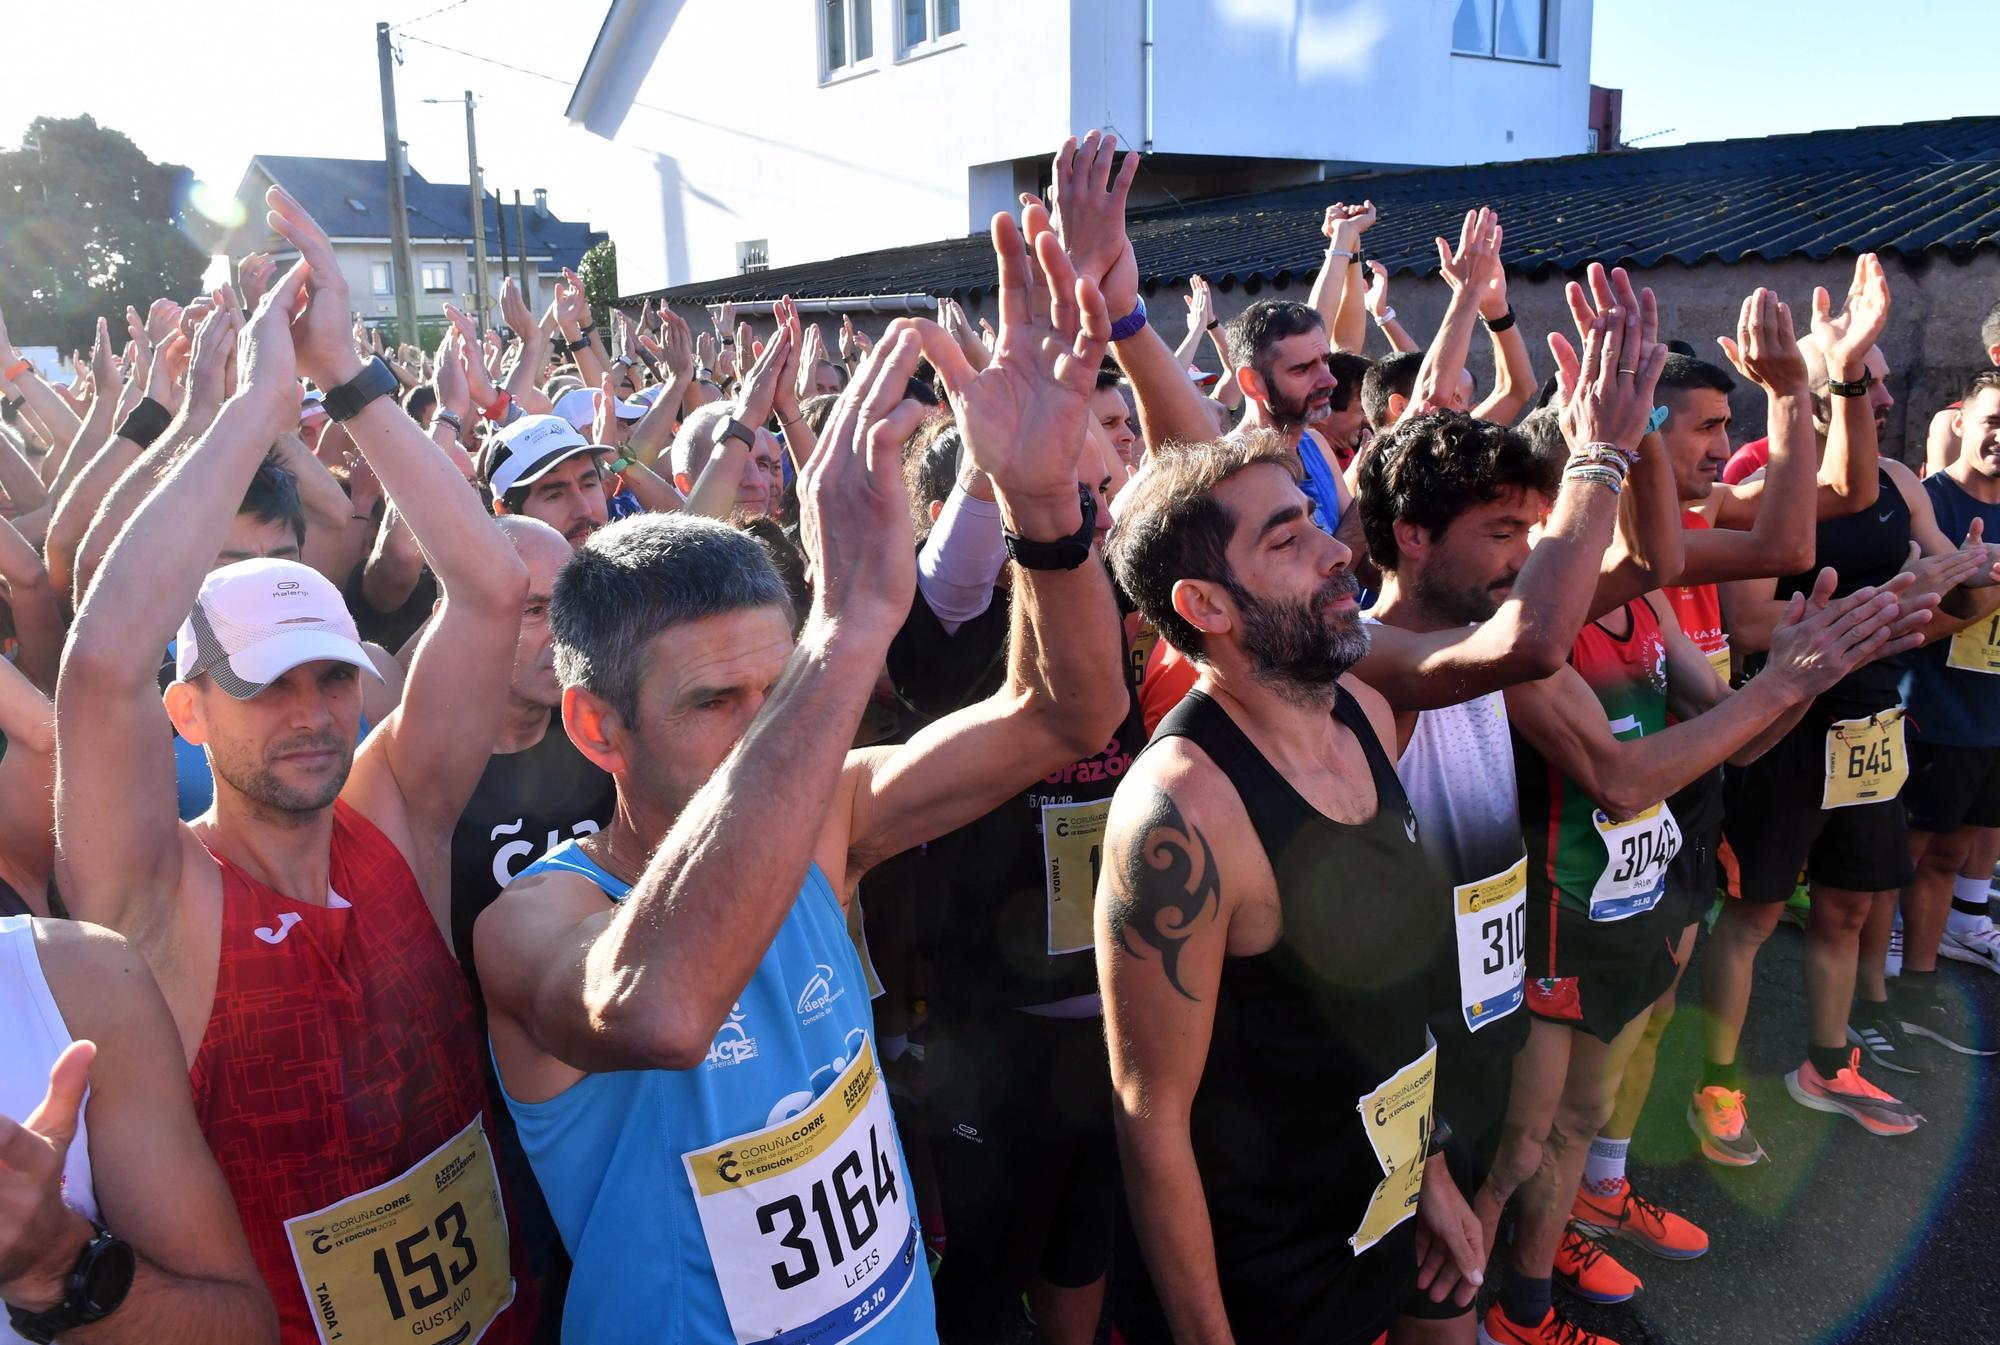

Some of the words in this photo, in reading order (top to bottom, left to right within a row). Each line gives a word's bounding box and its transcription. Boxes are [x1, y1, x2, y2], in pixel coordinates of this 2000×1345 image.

[1847, 737, 1892, 778] 645
[1052, 856, 1061, 894] TANDA
[745, 1168, 755, 1177] IX
[756, 1156, 793, 1174] EDICIÓN
[794, 1145, 814, 1161] 2022
[331, 1194, 412, 1232] CORUÑACORRE
[756, 1124, 898, 1290] 3164
[335, 1239, 344, 1247] IX
[345, 1226, 377, 1244] EDICIÓN
[378, 1218, 397, 1232] 2022
[374, 1201, 478, 1320] 153
[844, 1248, 880, 1289] LEIS
[316, 1282, 338, 1330] TANDA
[331, 1332, 342, 1340] 1
[412, 1288, 471, 1336] GUSTAVO
[853, 1286, 886, 1322] 23.10
